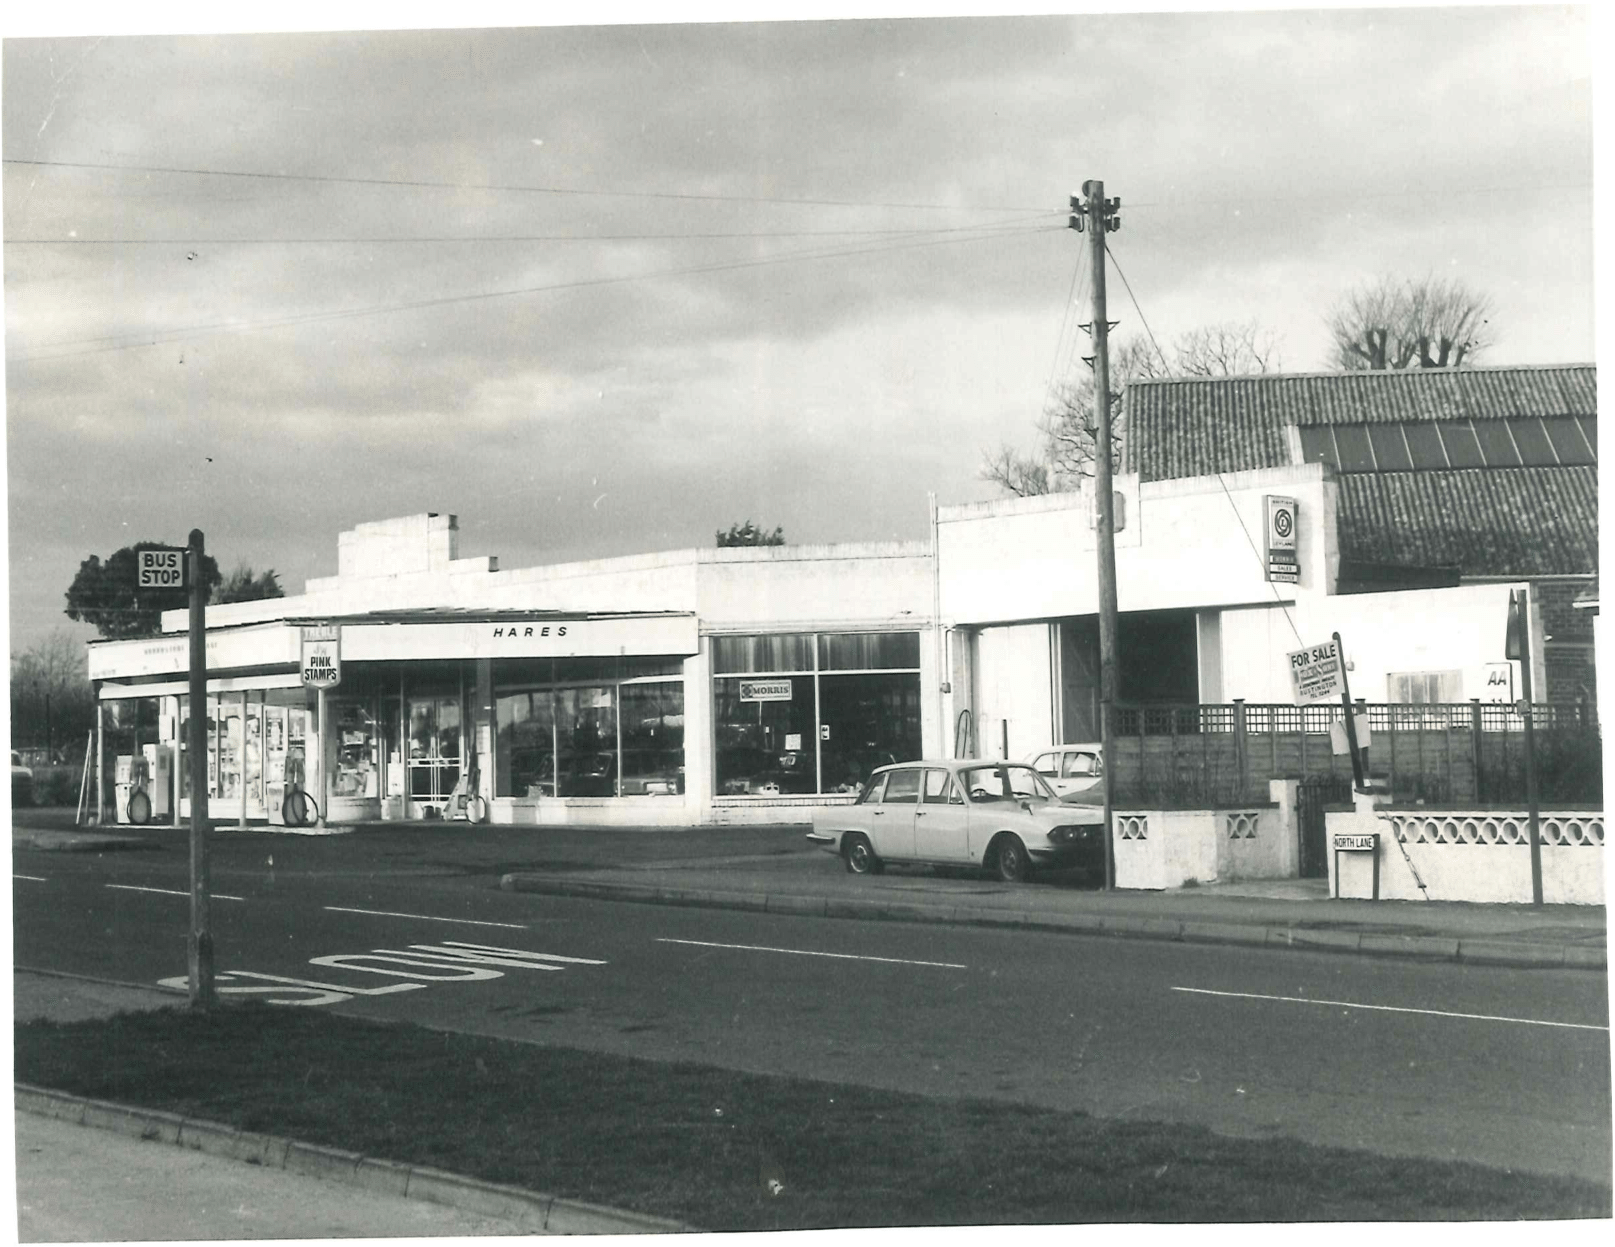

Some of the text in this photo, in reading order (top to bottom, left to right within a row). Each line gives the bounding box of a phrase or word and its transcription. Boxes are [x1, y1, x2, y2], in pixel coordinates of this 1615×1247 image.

[144, 553, 177, 568] BUS
[141, 569, 181, 584] STOP
[493, 626, 567, 637] HARES
[311, 656, 331, 667] PINK
[1291, 644, 1336, 668] FOR SALE
[304, 668, 337, 680] STAMPS
[1487, 671, 1506, 686] AA
[753, 686, 789, 695] MORRIS
[1334, 837, 1372, 848] NORTH LANE
[157, 940, 608, 1006] SLOW
